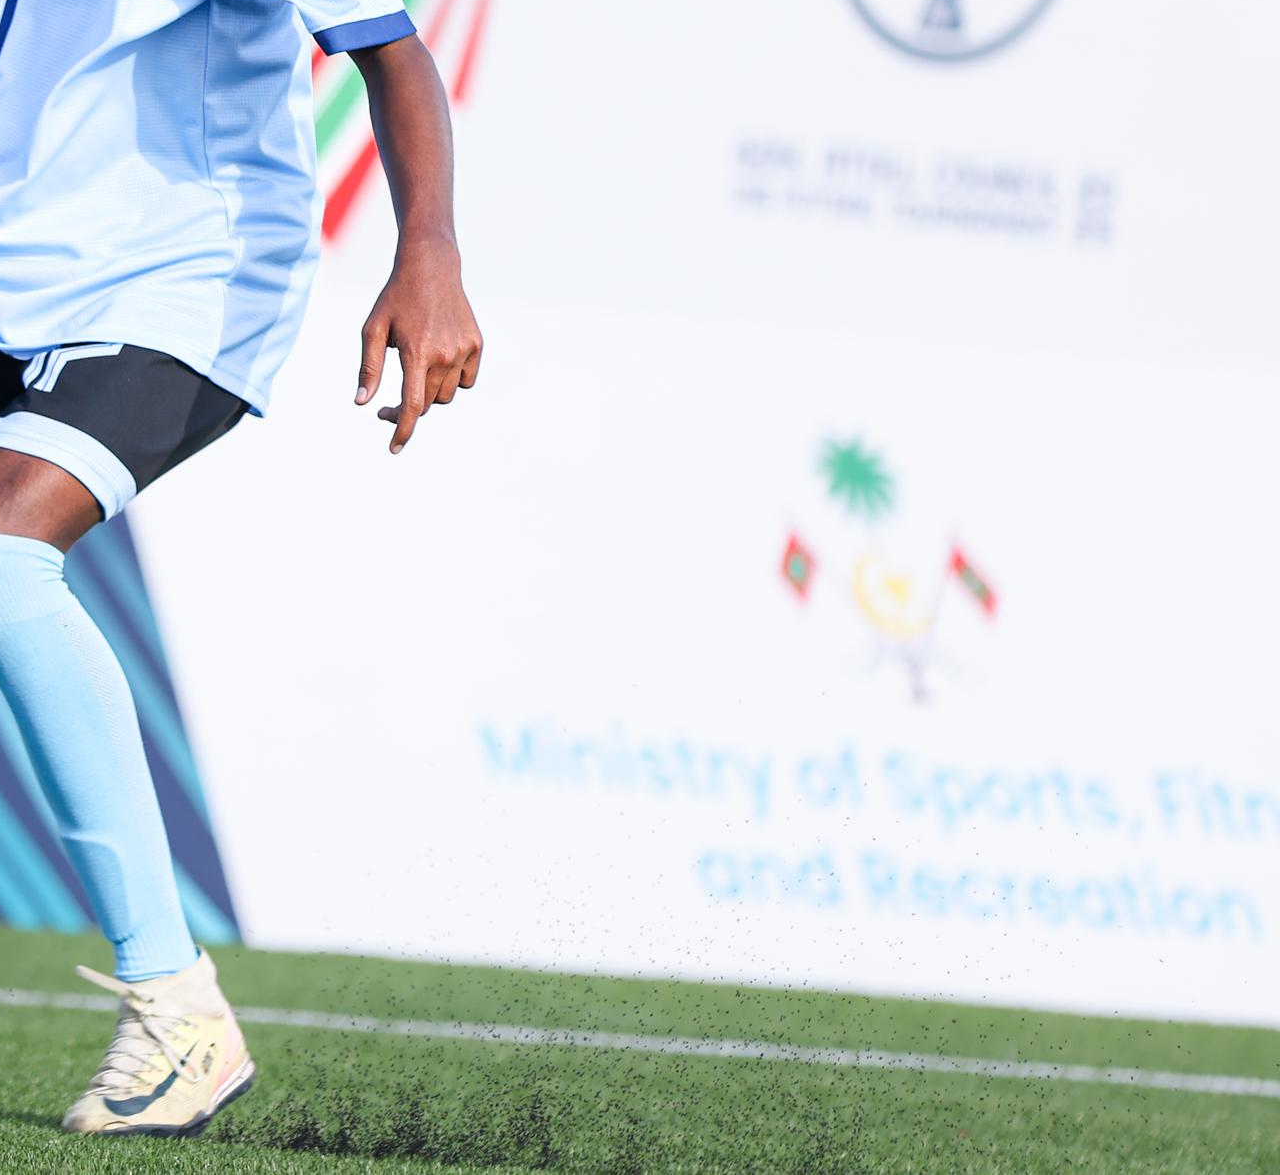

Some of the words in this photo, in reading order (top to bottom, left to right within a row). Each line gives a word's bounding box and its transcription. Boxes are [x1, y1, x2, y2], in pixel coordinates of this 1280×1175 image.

[474, 714, 775, 822] Ministry
[793, 736, 867, 811] of
[693, 845, 844, 911] and
[854, 847, 1266, 941] Recreation
